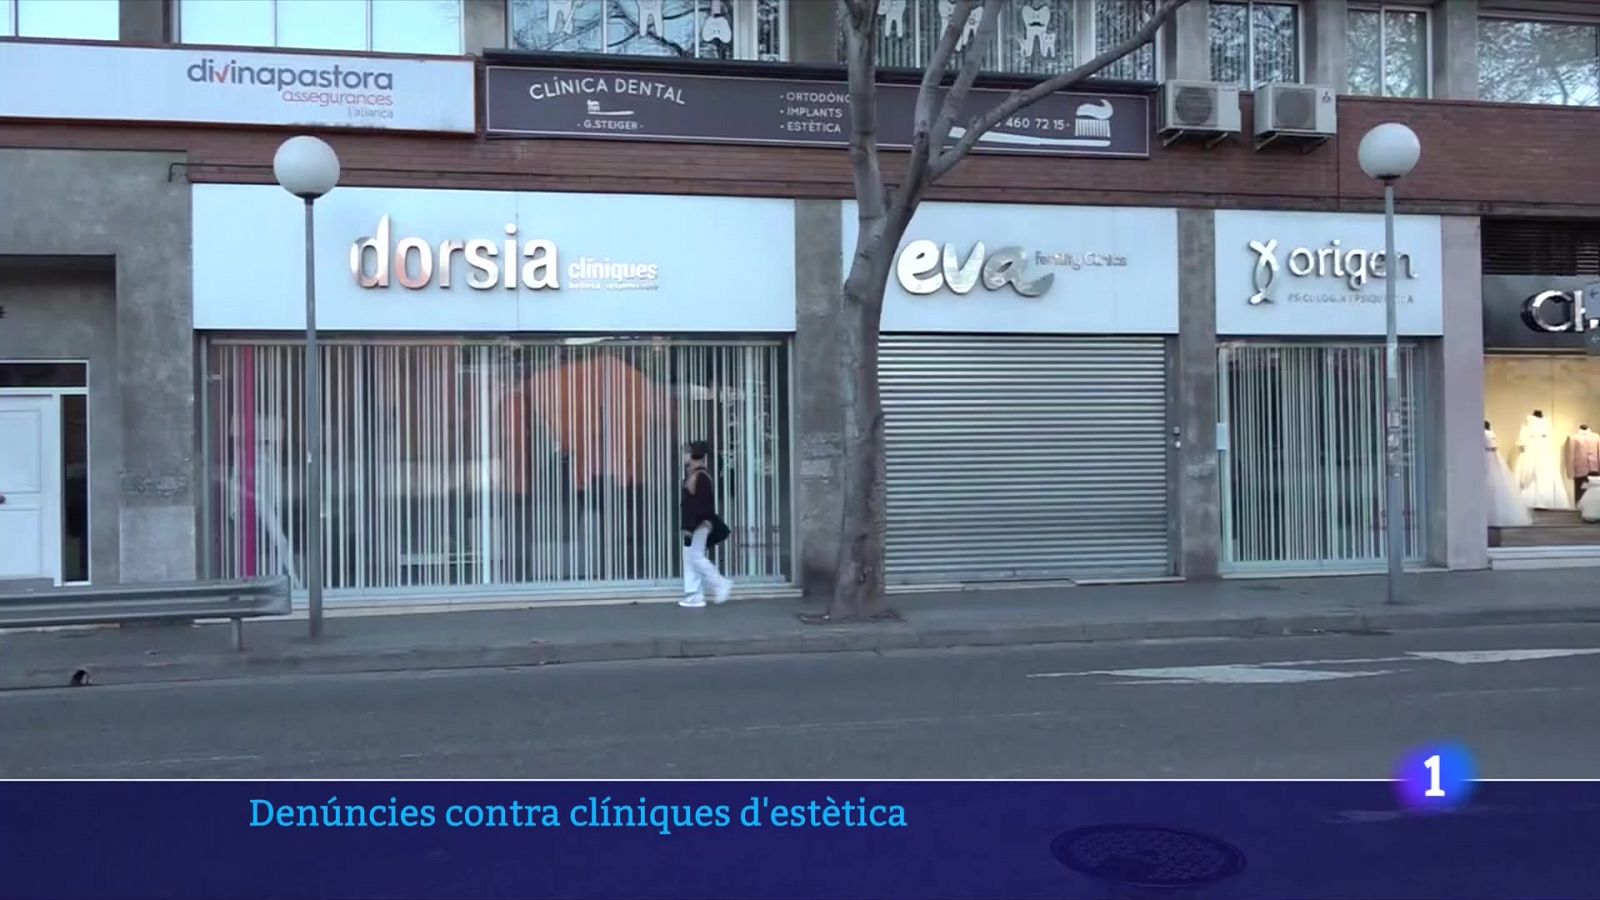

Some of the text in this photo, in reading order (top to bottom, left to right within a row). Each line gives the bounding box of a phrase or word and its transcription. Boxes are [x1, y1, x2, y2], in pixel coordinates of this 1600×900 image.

[187, 58, 394, 91] divinapastora
[282, 90, 394, 107] assegurances
[529, 76, 686, 105] CLÍNICA DENTAL
[583, 119, 638, 130] G.STEIGER
[787, 107, 843, 118] IMPLANTS
[1006, 117, 1031, 129] 460
[1035, 118, 1049, 130] 72
[350, 213, 560, 290] dorsia
[1287, 239, 1419, 290] origen
[896, 239, 1055, 297] eva
